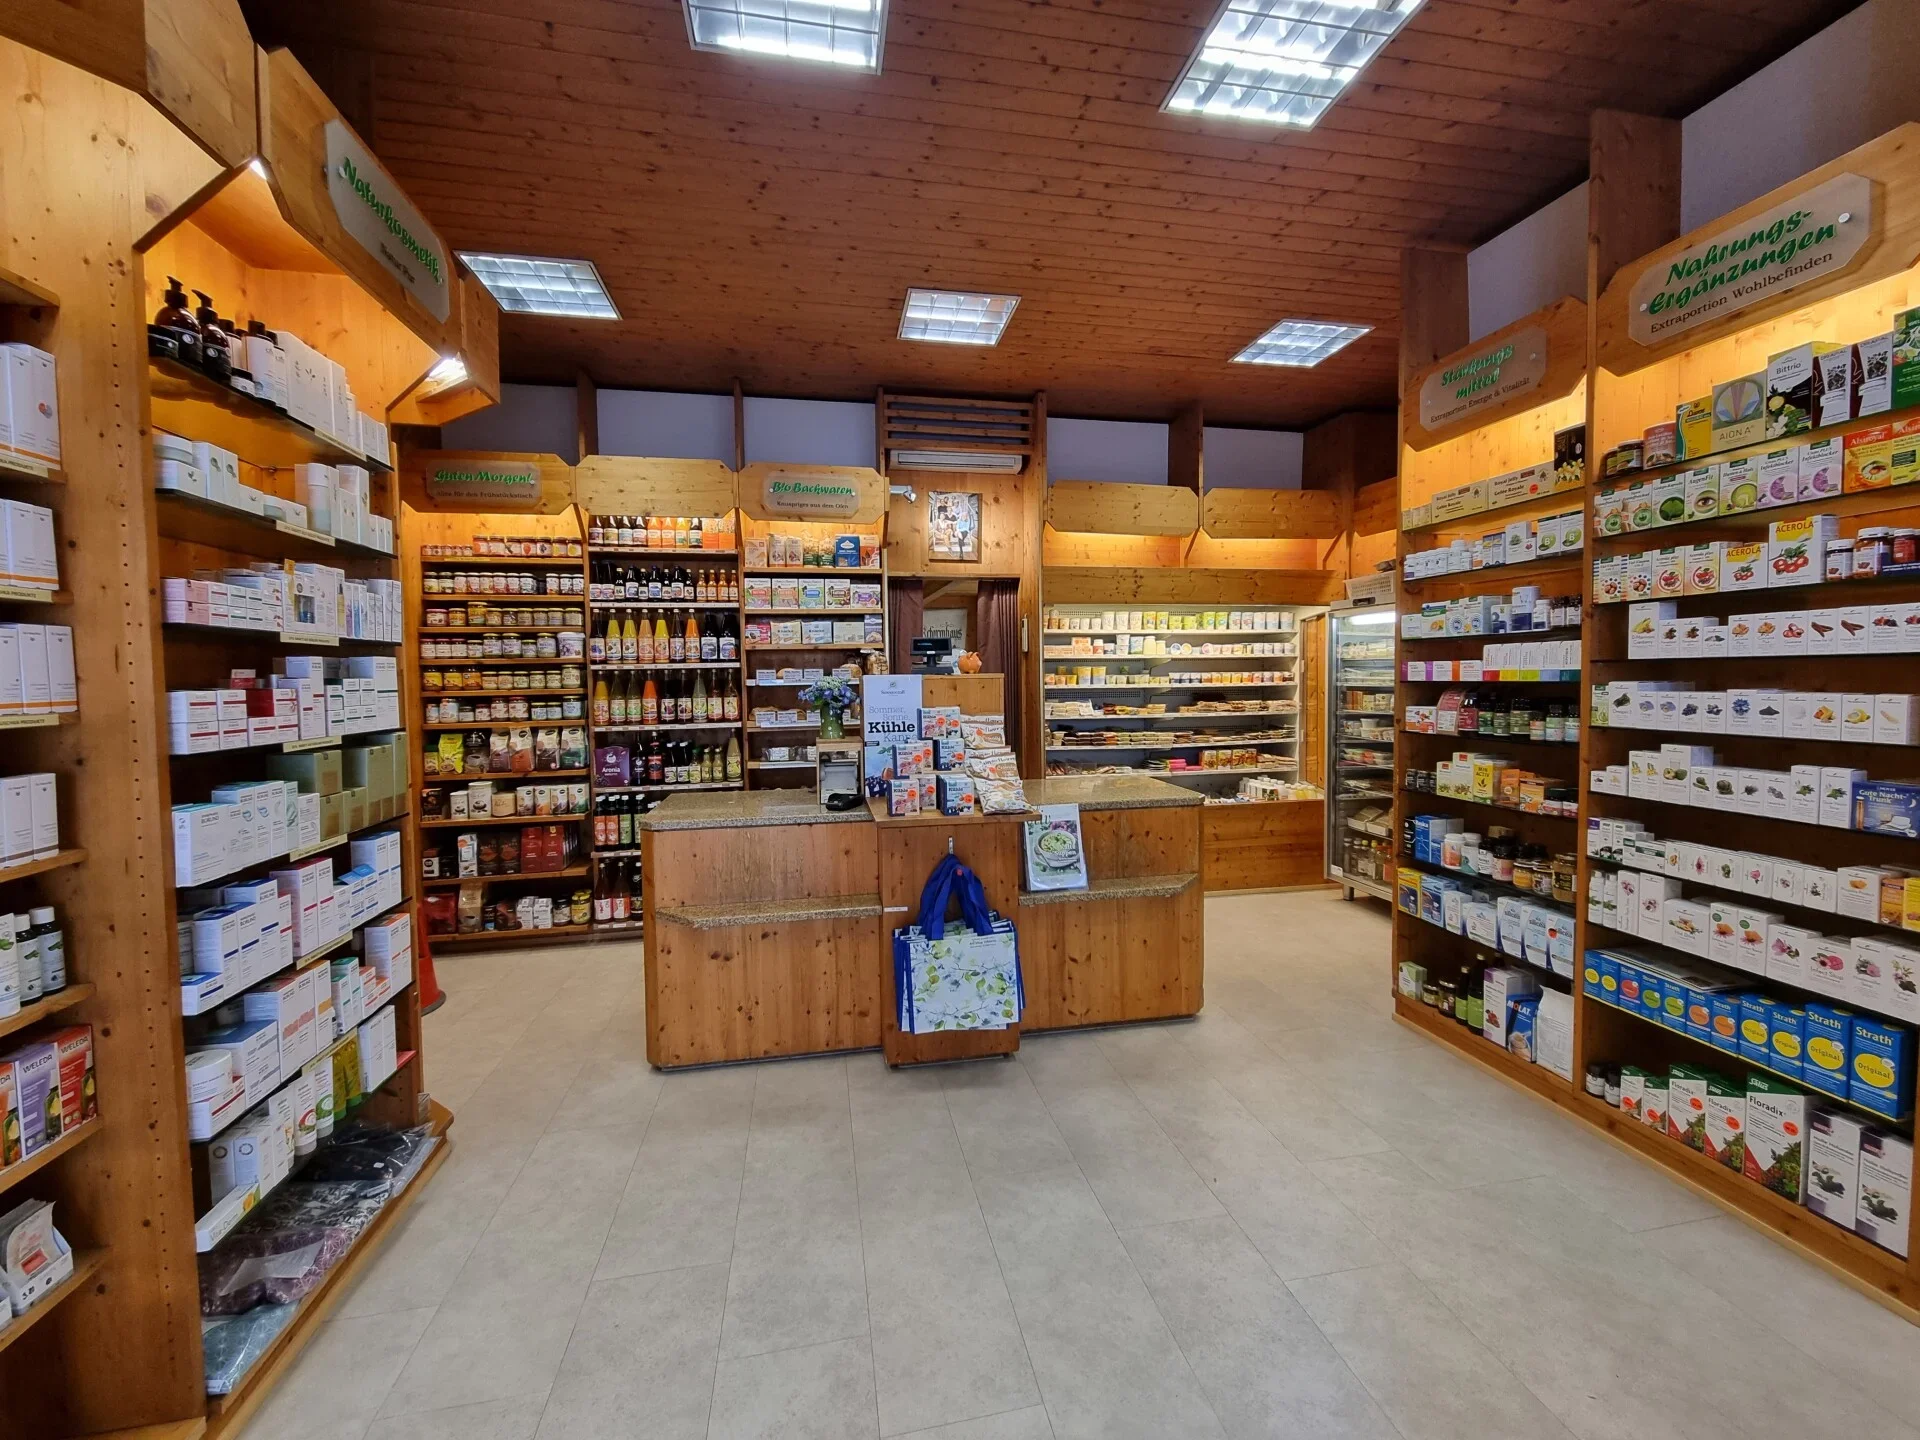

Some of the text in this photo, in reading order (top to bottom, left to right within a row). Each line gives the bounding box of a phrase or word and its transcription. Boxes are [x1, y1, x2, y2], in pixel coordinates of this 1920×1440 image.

[344, 157, 442, 284] Naturkosmetik
[1665, 208, 1813, 286] Nahrungs-
[1650, 253, 1833, 334] Extraportion Wohlbefinden
[1776, 362, 1802, 375] Bittrio
[1430, 404, 1467, 423] Extraportion
[1468, 394, 1493, 409] Energie
[1501, 377, 1531, 394] Vitalität
[434, 469, 533, 485] Guten Morgen!
[480, 491, 534, 500] Frühstückstisch
[772, 481, 853, 496] Bio Backwaren
[1775, 521, 1814, 534] ACEROLA
[1725, 544, 1762, 557] ACEROLA
[868, 721, 916, 734] Kühle
[1859, 789, 1907, 801] Gute Nacht-
[1869, 795, 1892, 804] Trunk
[1664, 982, 1681, 992] Strath
[1689, 991, 1705, 1001] Strath
[1713, 1000, 1731, 1010] Strath
[1742, 1000, 1765, 1013] Strath
[1772, 1011, 1797, 1025] Strath
[1808, 1011, 1841, 1030] Strath
[1743, 1026, 1766, 1038] Original
[1855, 1026, 1892, 1046] Strath
[60, 1036, 89, 1054] WELEDA
[1775, 1038, 1798, 1051] Original
[1810, 1045, 1841, 1062] Original
[22, 1053, 53, 1074] WELEDA
[1858, 1062, 1891, 1080] Original
[1671, 1080, 1694, 1095] Floradix
[1708, 1097, 1733, 1113] Floradix
[1749, 1095, 1785, 1117] Floradix
